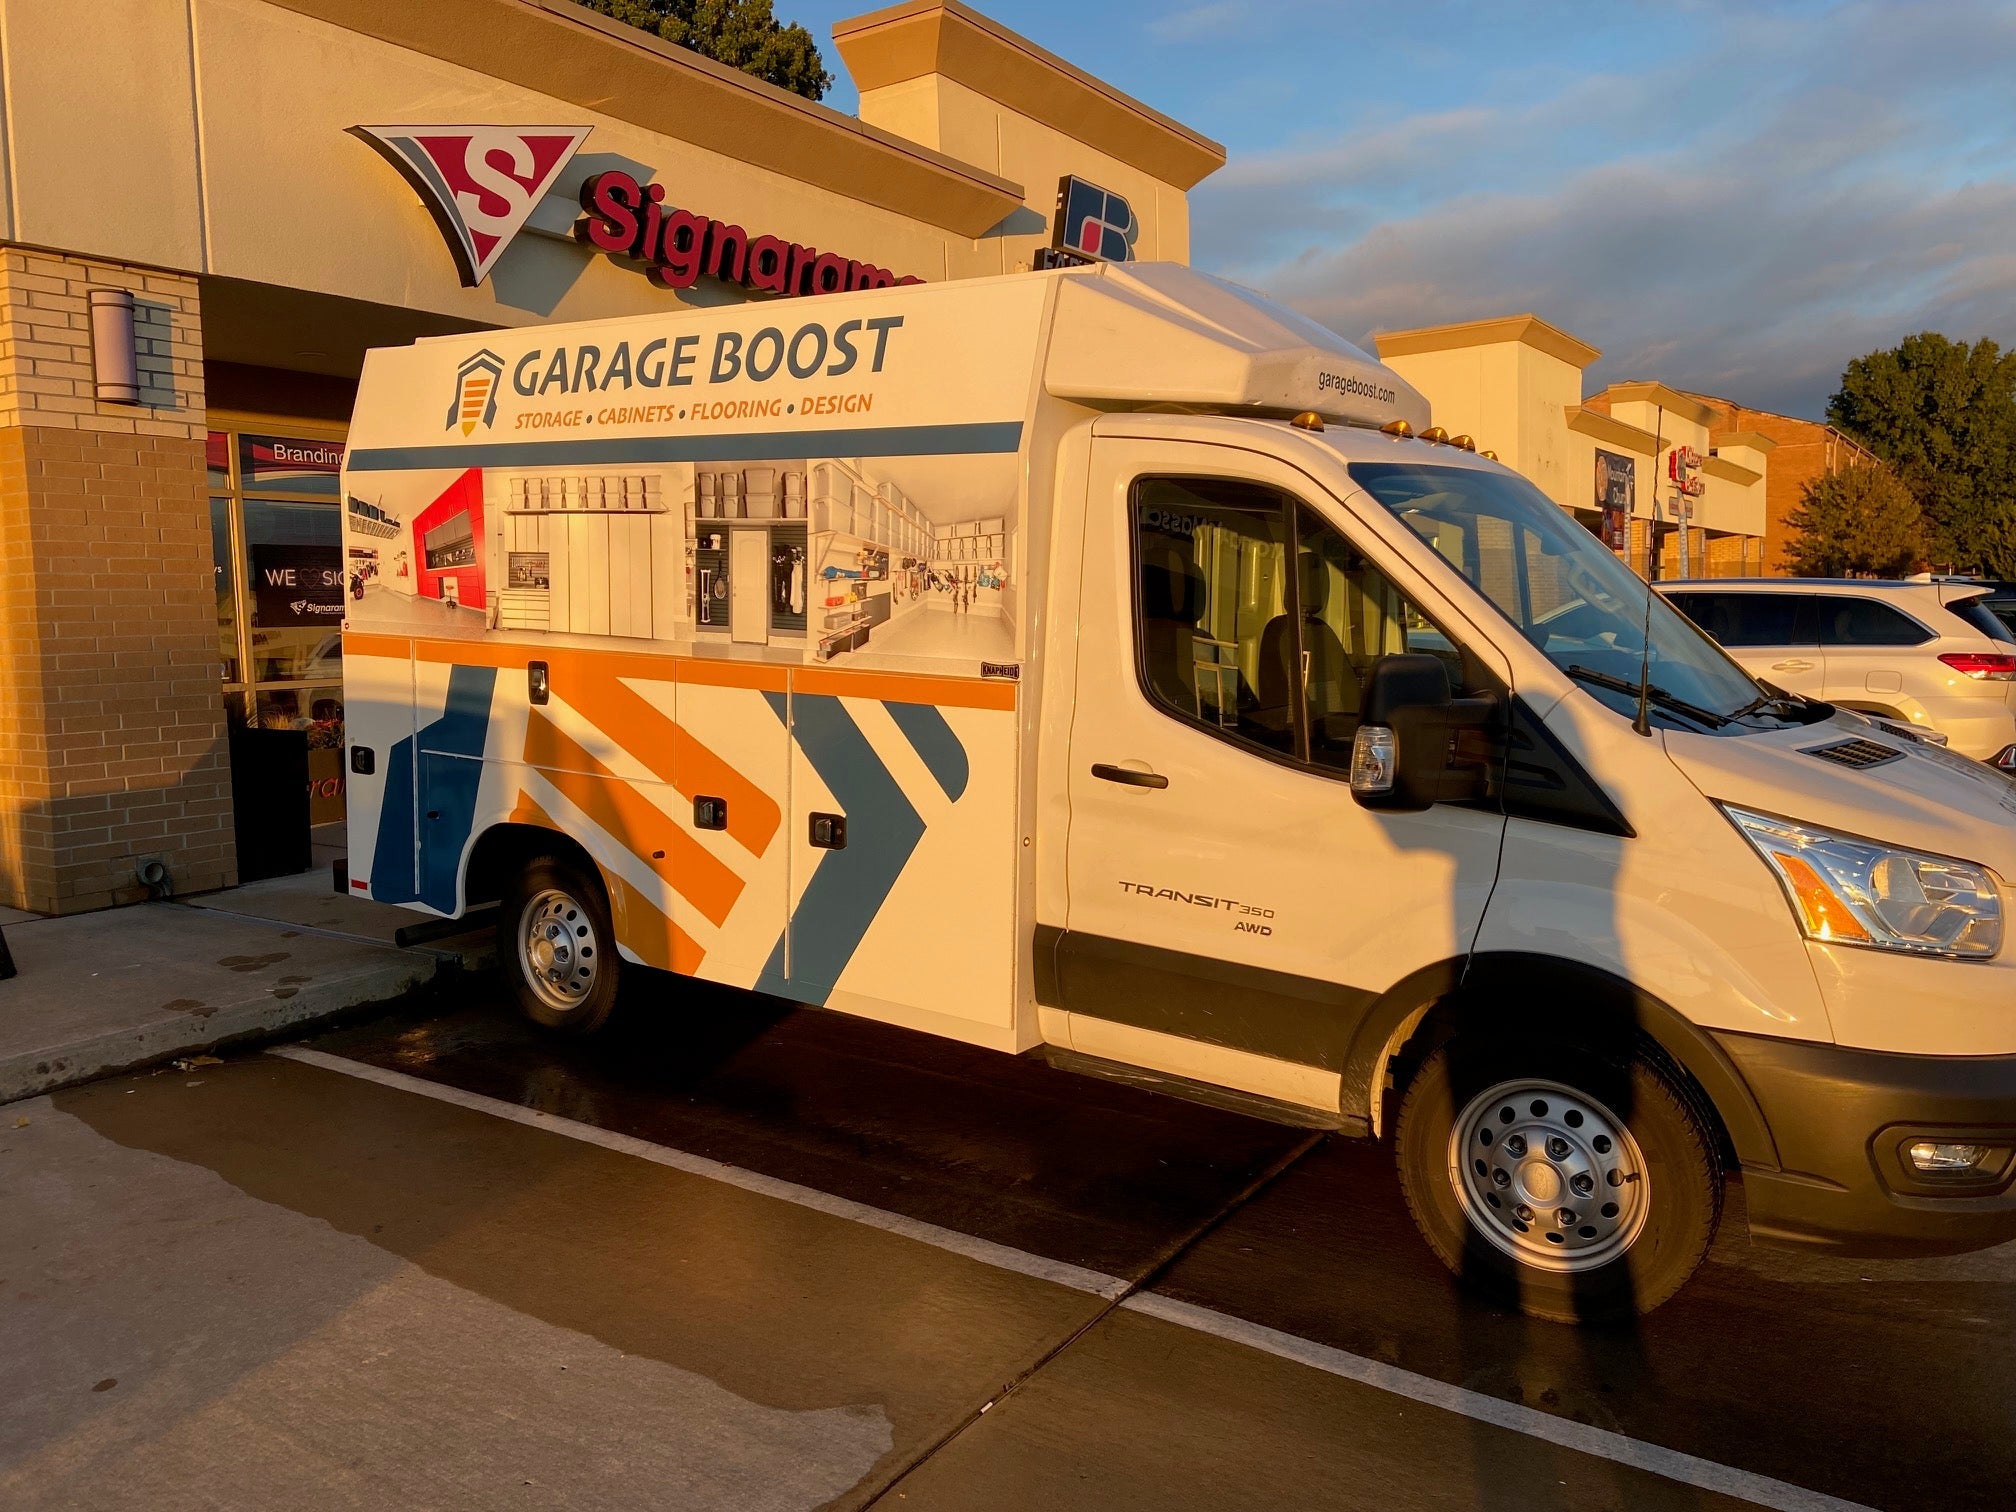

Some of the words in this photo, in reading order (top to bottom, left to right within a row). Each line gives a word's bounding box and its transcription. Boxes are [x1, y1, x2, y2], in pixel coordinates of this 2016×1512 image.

[582, 171, 926, 297] Signaram
[513, 335, 700, 397] GARAGE
[709, 315, 904, 384] BOOST
[1319, 371, 1395, 405] garageboost.com
[515, 410, 582, 430] STORAGE
[598, 404, 674, 425] CABINETS
[690, 398, 782, 421] FLOORING
[801, 393, 873, 416] DESIGN
[265, 569, 296, 586] WE
[310, 778, 345, 799] ra
[1234, 921, 1272, 937] AWD
